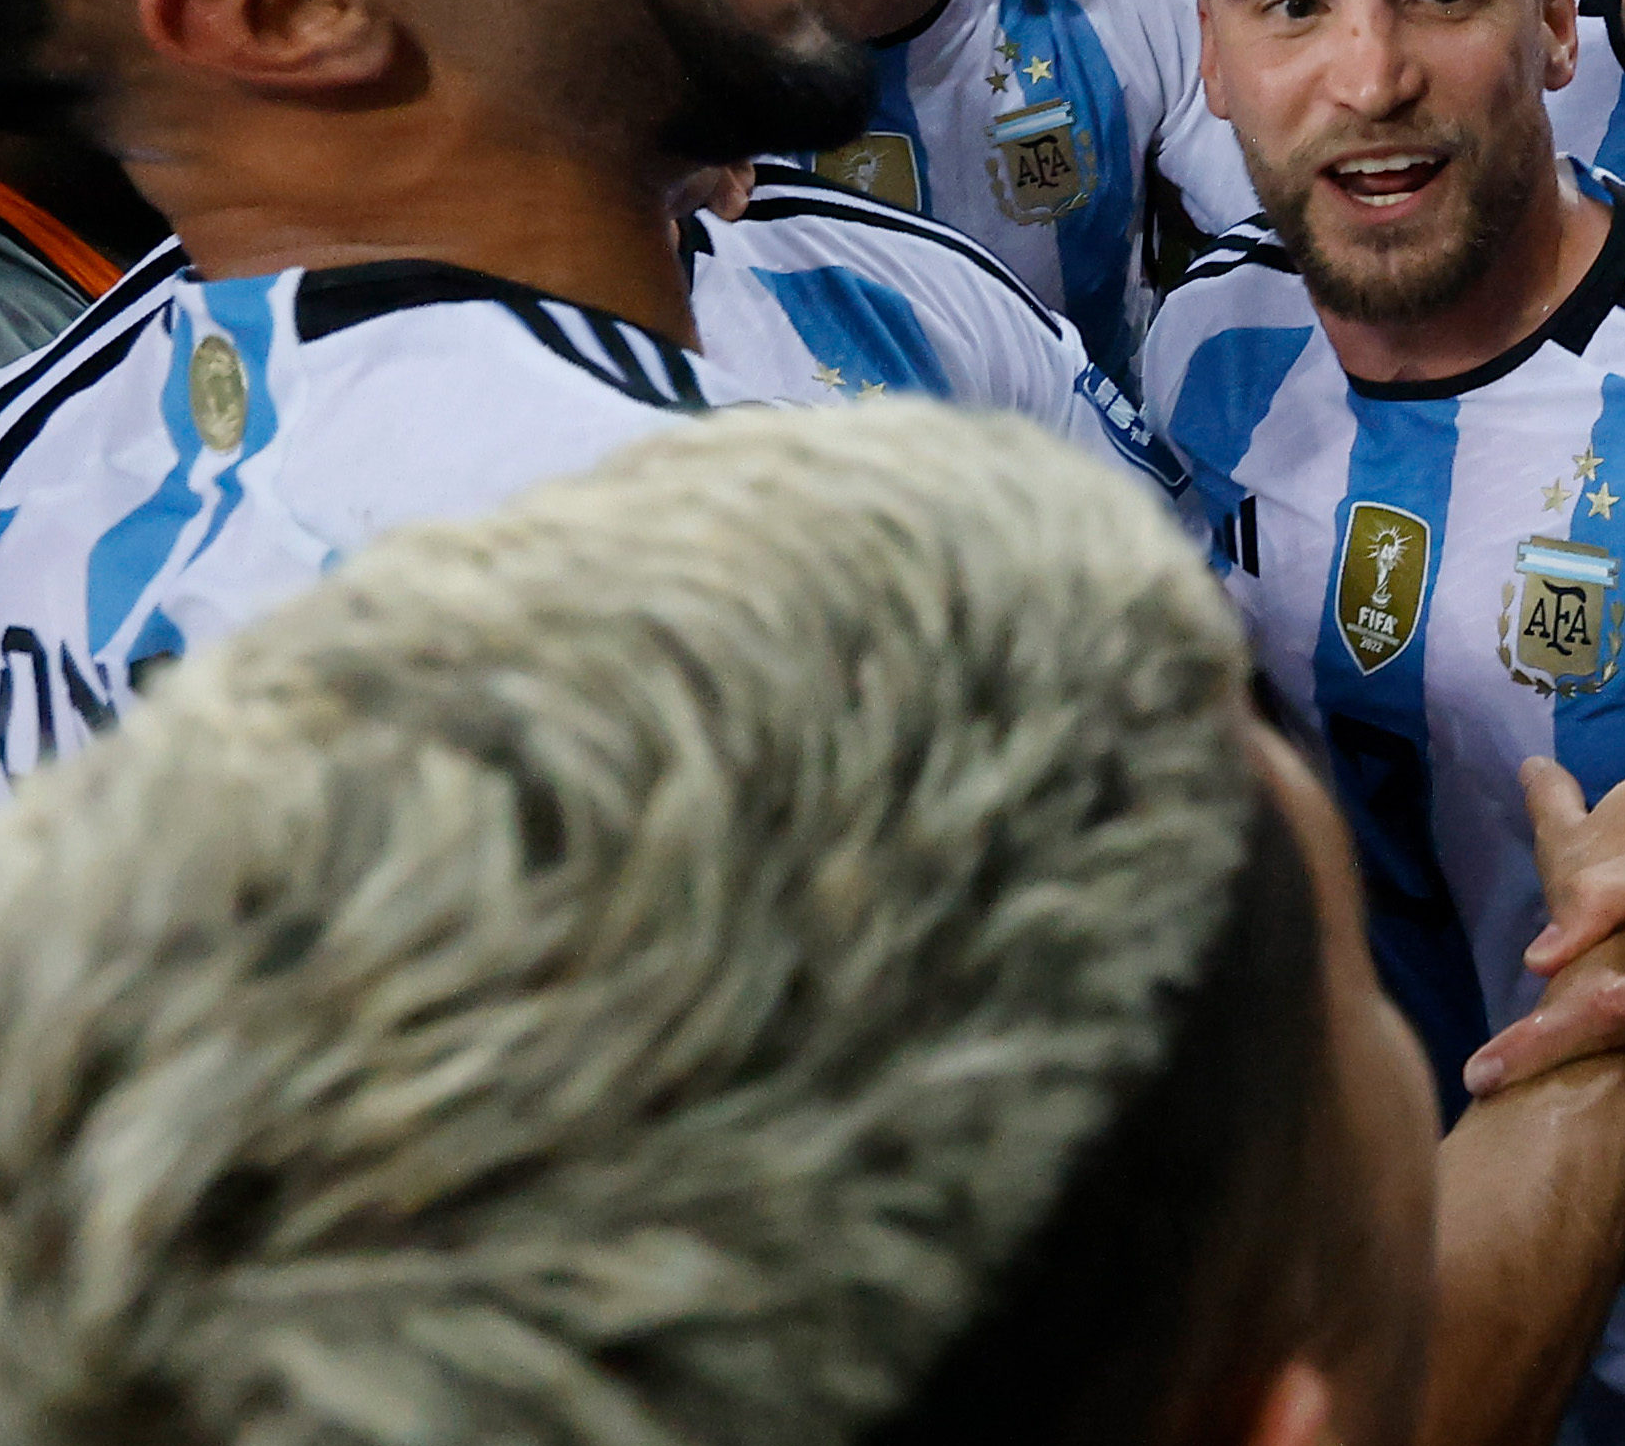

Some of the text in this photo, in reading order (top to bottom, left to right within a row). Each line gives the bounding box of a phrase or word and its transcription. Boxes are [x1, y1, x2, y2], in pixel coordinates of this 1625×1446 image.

[1017, 134, 1071, 189] AFA
[1357, 605, 1397, 634] FIFA
[1524, 579, 1592, 656] AFA
[1359, 636, 1384, 653] 2022
